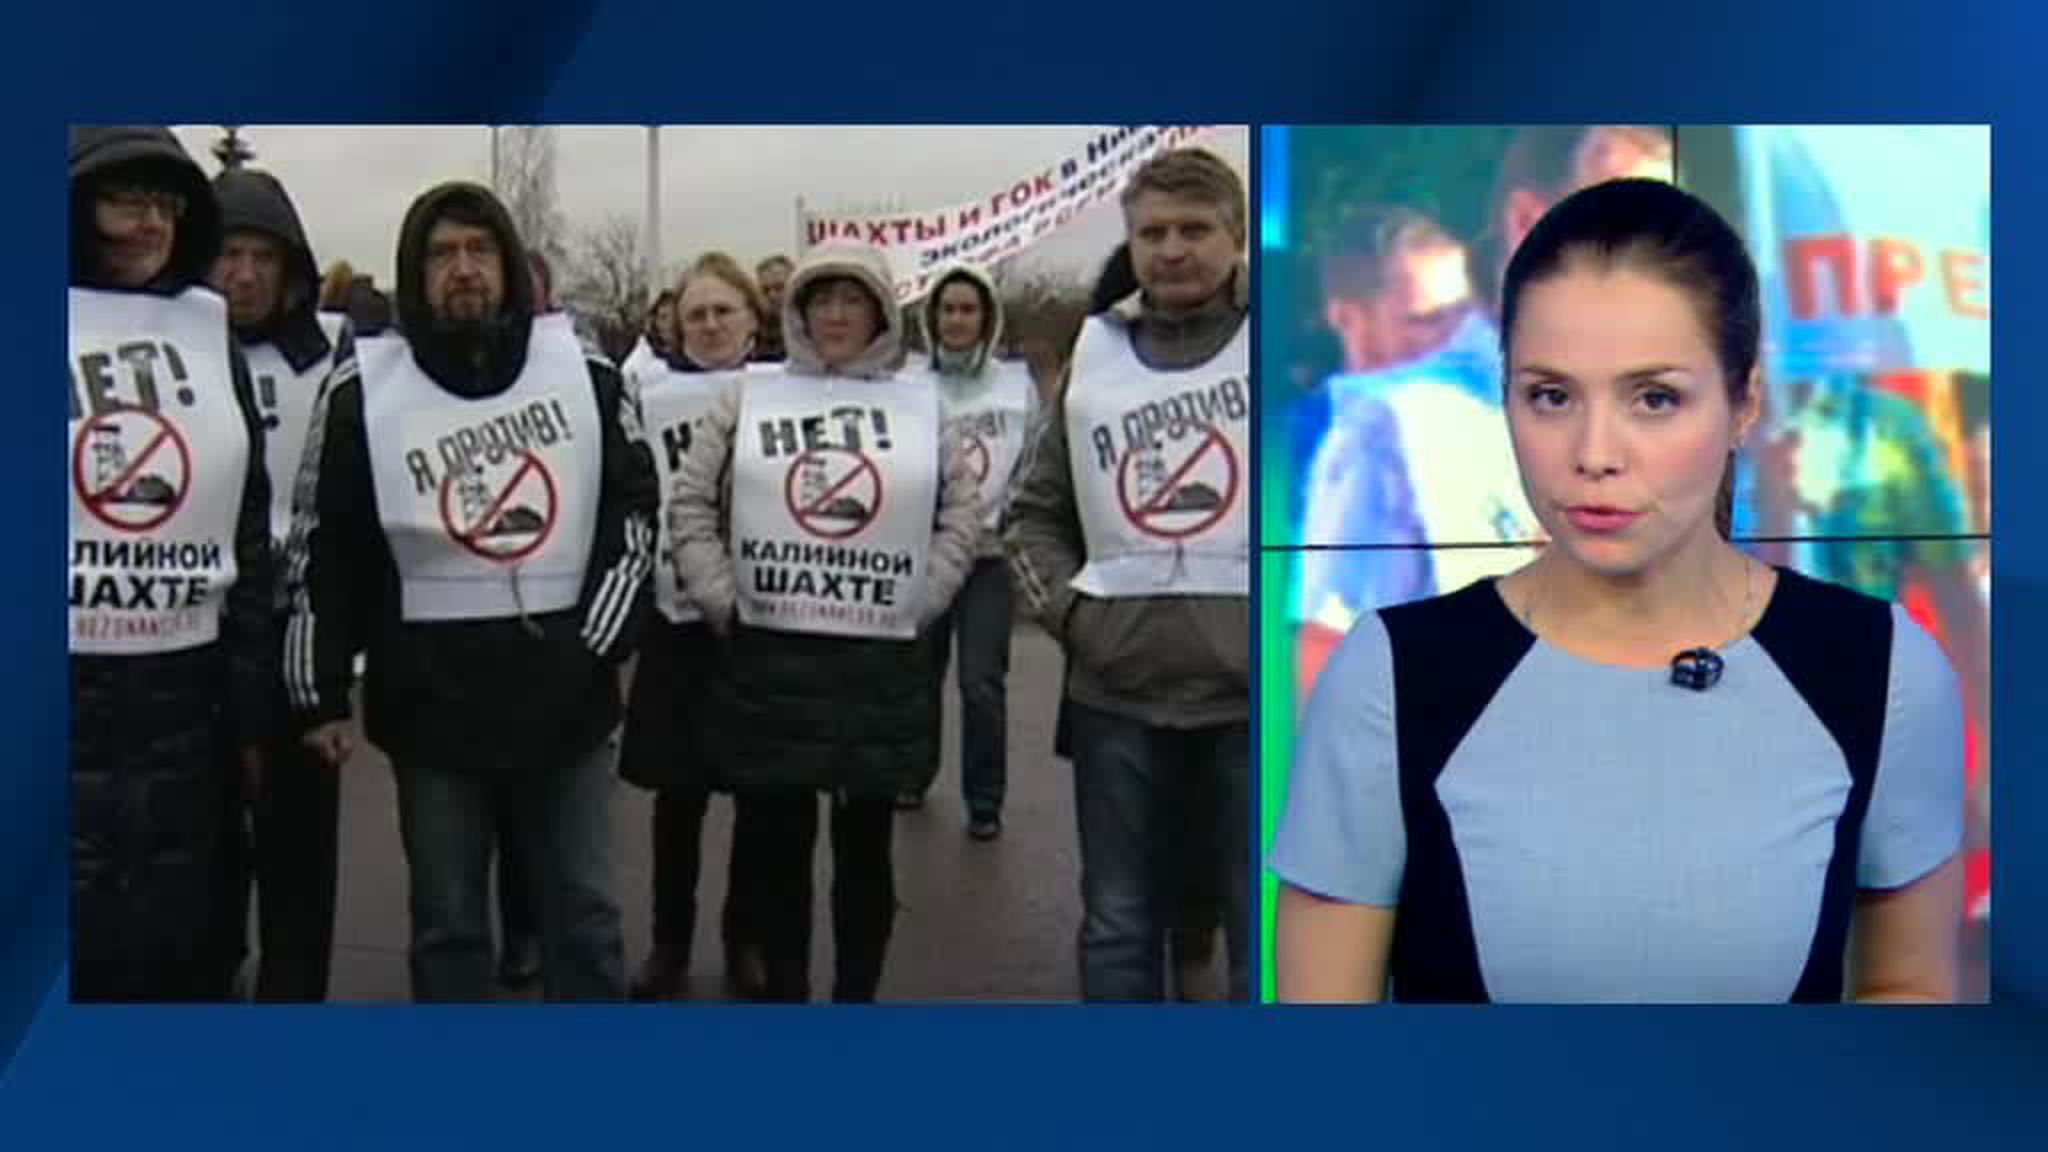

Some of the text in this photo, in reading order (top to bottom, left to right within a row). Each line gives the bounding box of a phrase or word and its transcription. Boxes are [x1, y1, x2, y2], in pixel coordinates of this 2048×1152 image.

[806, 214, 946, 248] ШАХТЫ
[958, 206, 981, 230] И
[991, 170, 1053, 217] ГОК
[1782, 232, 1988, 320] ПРЕ
[406, 400, 574, 496] Я ПРОТИВ!
[758, 407, 894, 459] НЕТ!
[1092, 424, 1118, 471] Я
[754, 570, 897, 607] ШАХТЕ
